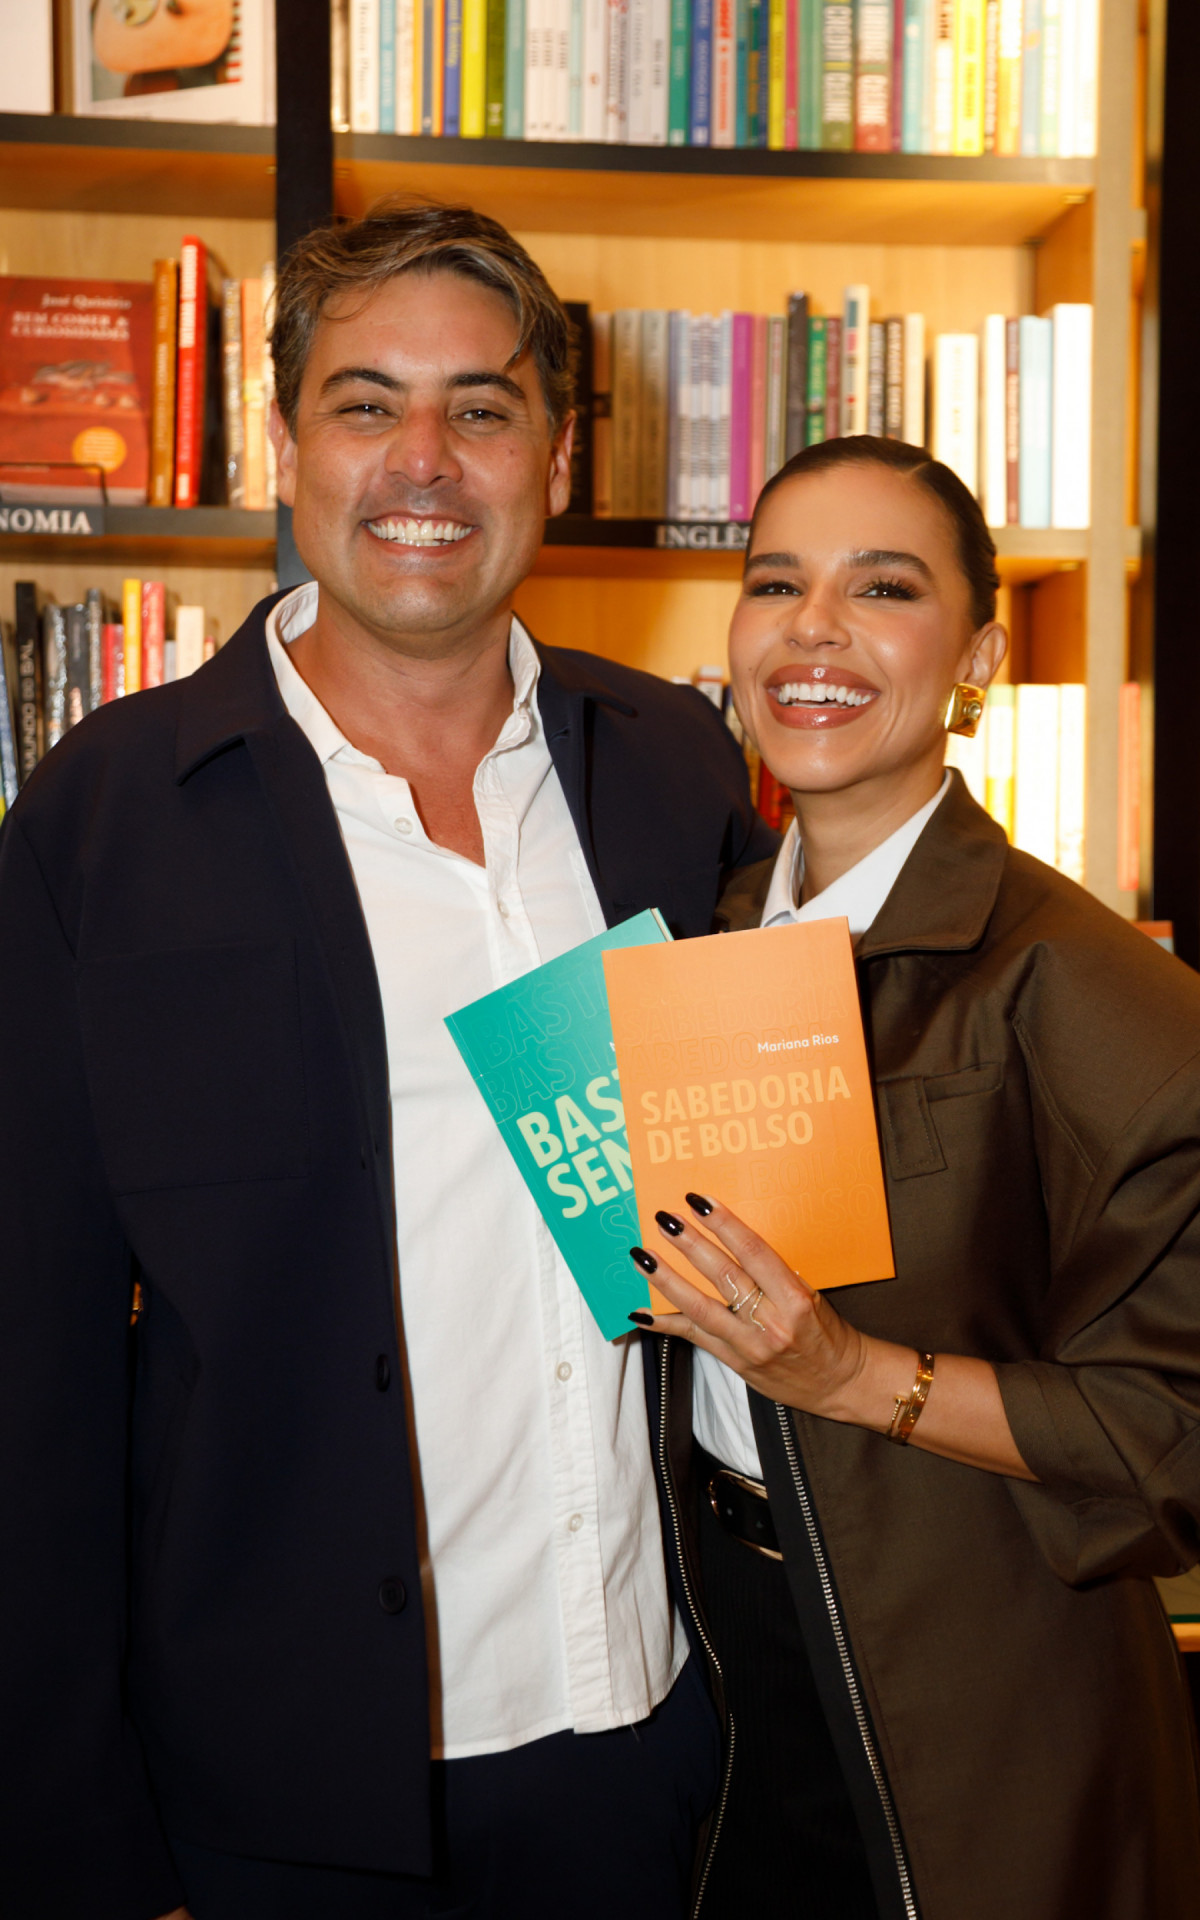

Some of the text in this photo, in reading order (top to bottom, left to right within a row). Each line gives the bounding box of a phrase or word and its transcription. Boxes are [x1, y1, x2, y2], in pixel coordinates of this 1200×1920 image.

[51, 312, 111, 327] COMER
[757, 1033, 840, 1053] Mariana Rios
[516, 1070, 626, 1168] BAS
[640, 1066, 851, 1125] SABEDORIA
[646, 1111, 814, 1164] DE BOLSO
